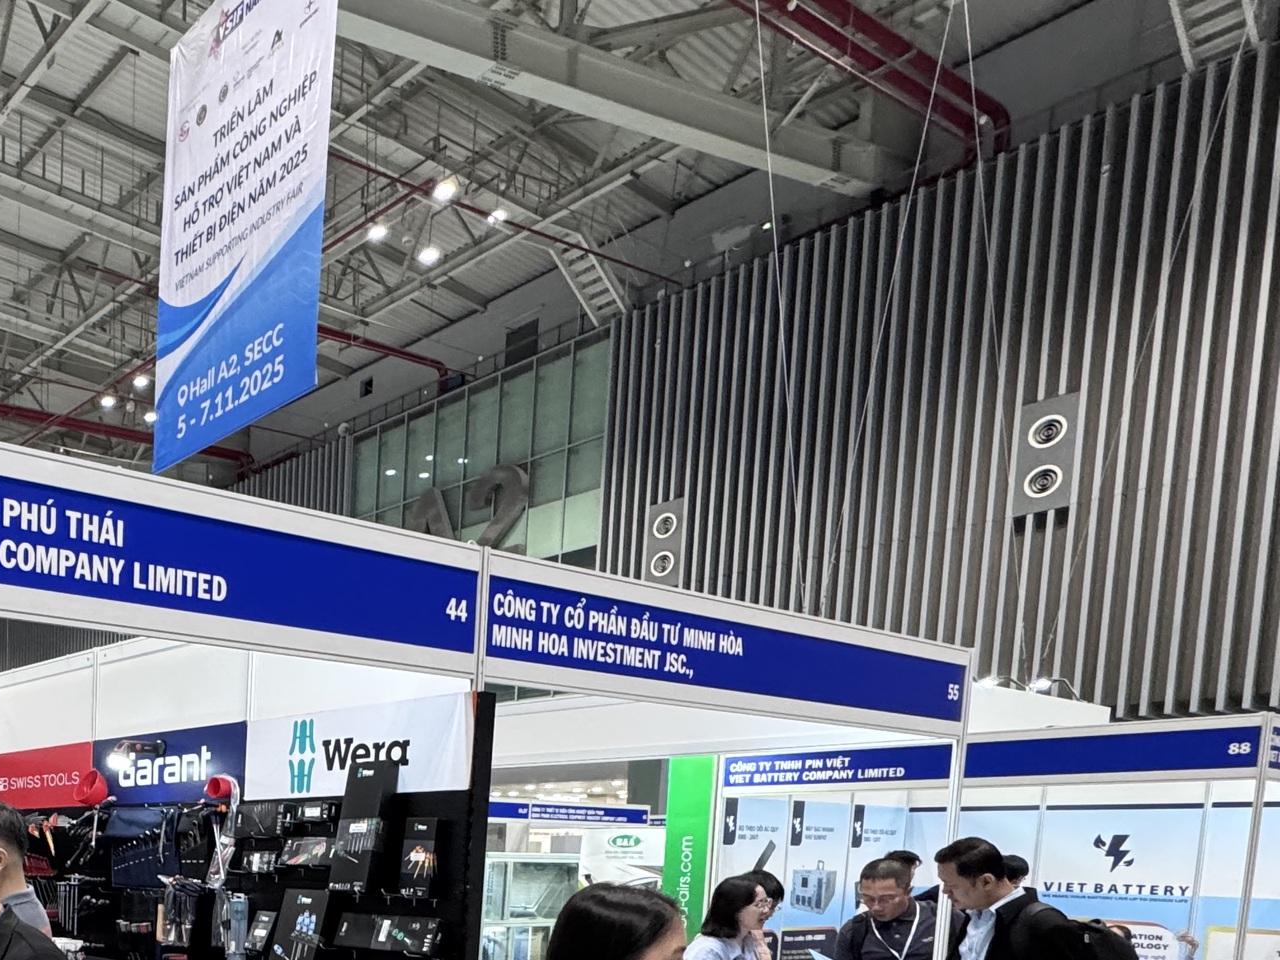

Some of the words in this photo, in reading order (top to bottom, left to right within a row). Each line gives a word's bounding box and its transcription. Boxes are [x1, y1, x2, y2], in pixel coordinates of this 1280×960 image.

[213, 106, 245, 148] TRIỂN
[248, 78, 273, 117] LÃM
[174, 181, 195, 211] SẢN
[198, 149, 230, 192] PHẨM
[233, 117, 266, 160] CÔNG
[269, 70, 317, 128] NGHIỆP
[183, 201, 200, 233] HỖ
[202, 183, 224, 217] TRỢ
[226, 161, 252, 195] VIỆT
[253, 134, 282, 174] NAM
[285, 115, 301, 144] VÀ
[174, 230, 204, 267] THIẾT
[206, 221, 216, 243] BỊ
[219, 197, 245, 233] ĐIỆN
[248, 170, 277, 209] NĂM
[279, 143, 308, 183] 2025
[175, 263, 204, 292] VIETNAM
[205, 227, 248, 270] SUPPORTING
[249, 199, 285, 237] INDUSTRY
[286, 182, 304, 205] FAIR
[190, 367, 215, 401] Hall
[217, 354, 241, 384] A2,
[244, 323, 284, 366] SECC
[177, 414, 186, 439] 5
[200, 354, 284, 426] 7.11.2025
[3, 498, 57, 535] PHÚ
[66, 510, 124, 548] THÁI
[0, 539, 124, 586] COMPANY
[134, 562, 227, 602] LIMITED
[446, 597, 468, 623] 44
[493, 590, 535, 622] CÔNG
[540, 602, 560, 625] TY
[564, 597, 587, 629] CỔ
[589, 605, 626, 637] PHẦN
[631, 612, 658, 642] ĐẦU
[662, 622, 681, 646] TƯ
[683, 628, 715, 652] MINH
[719, 630, 743, 657] HÒA
[492, 624, 533, 651] MINH
[538, 632, 568, 657] HOA
[573, 637, 661, 670] INVESTMENT
[664, 652, 693, 679] JSC.,
[947, 684, 959, 701] 55
[730, 760, 756, 773] CÔNG
[758, 762, 772, 771] TY
[774, 760, 802, 771] TNHH
[805, 759, 823, 769] PIN
[826, 755, 851, 770] VIỆT
[1228, 742, 1251, 754] 88
[10, 775, 41, 790] SWISS
[42, 771, 79, 787] TOOLS
[729, 774, 751, 784] VIET
[753, 772, 799, 783] BATTERY
[802, 770, 854, 781] COMPANY
[858, 768, 905, 779] LIMITED
[1044, 881, 1087, 893] VIET
[1094, 883, 1190, 897] BATTERY
[1131, 933, 1163, 941] ATION
[1133, 942, 1169, 950] OLOGY
